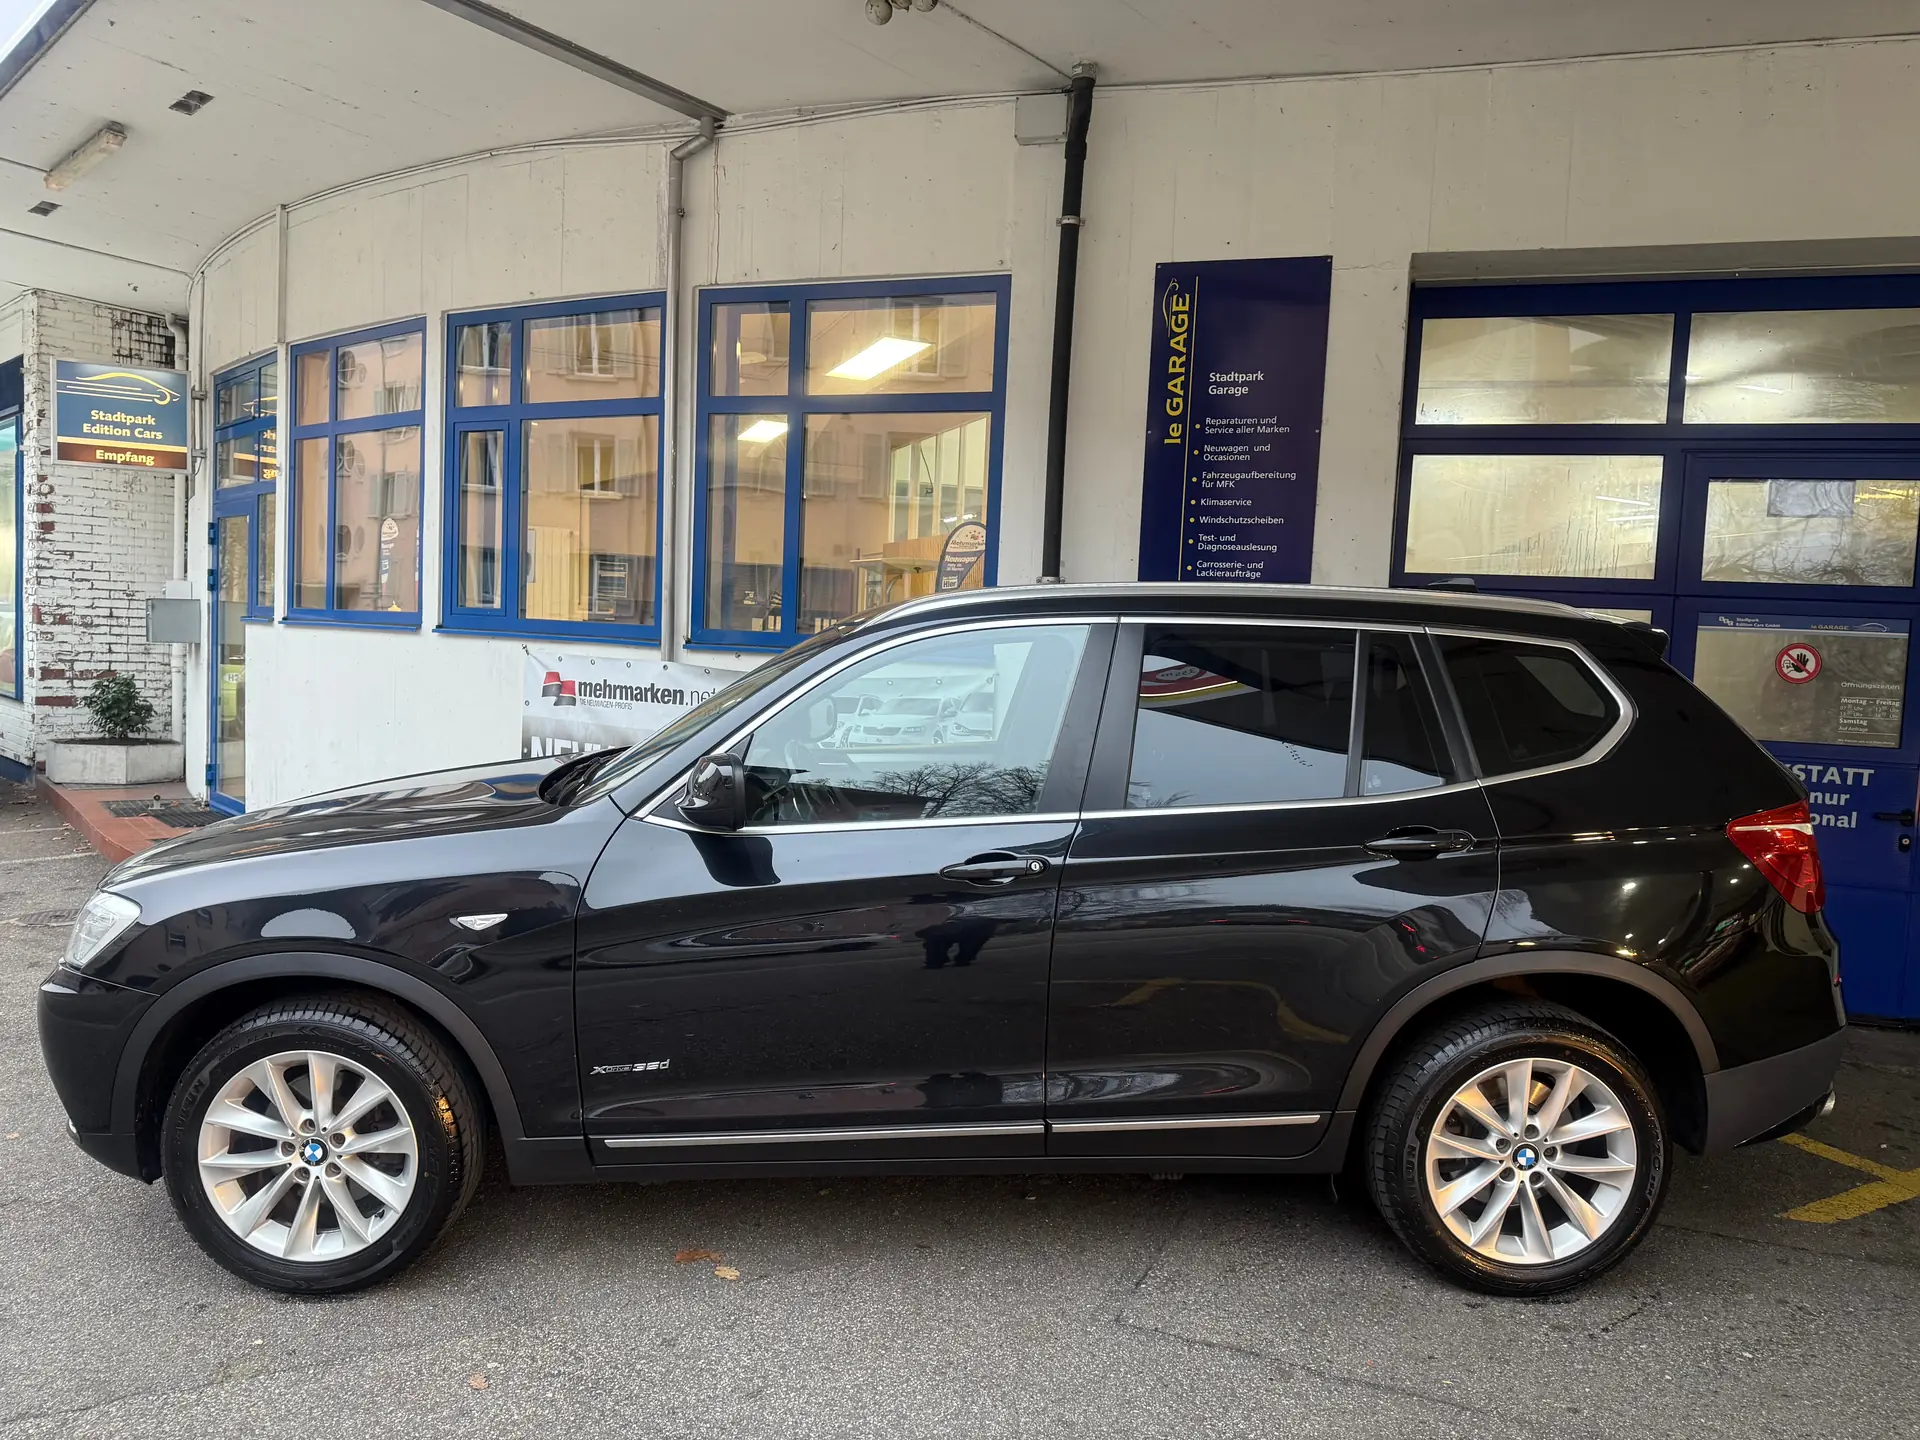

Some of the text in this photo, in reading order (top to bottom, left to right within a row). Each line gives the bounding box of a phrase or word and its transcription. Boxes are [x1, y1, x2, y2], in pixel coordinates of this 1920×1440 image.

[1164, 294, 1190, 444] le GARAGE
[1209, 371, 1264, 384] Stadtpark
[1208, 385, 1249, 396] Garage
[91, 409, 156, 425] Stadtpark
[1205, 416, 1278, 426] Reparaturen und
[83, 423, 163, 440] Edition Cars
[1205, 425, 1290, 434] Service aller Marken
[1204, 443, 1271, 454] Neuwagen und
[95, 449, 155, 466] Empfang
[1203, 453, 1250, 461] Occasionen
[1202, 471, 1296, 481] Fahrzeugaufbereitung
[1201, 479, 1235, 488] für MFK
[1200, 498, 1252, 506] Klimaservice
[1199, 516, 1284, 524] Windschutzscheiben
[1198, 533, 1236, 542] Test- und
[1197, 542, 1278, 553] Diagnoseauslesung
[1196, 560, 1264, 569] Carrosserie- und
[1196, 569, 1261, 579] Lackieraufträge
[1840, 698, 1867, 706] Montag
[1876, 699, 1900, 707] Freitag
[1840, 717, 1868, 726] Samstag
[1784, 764, 1875, 787] STATT
[1809, 791, 1850, 806] nur
